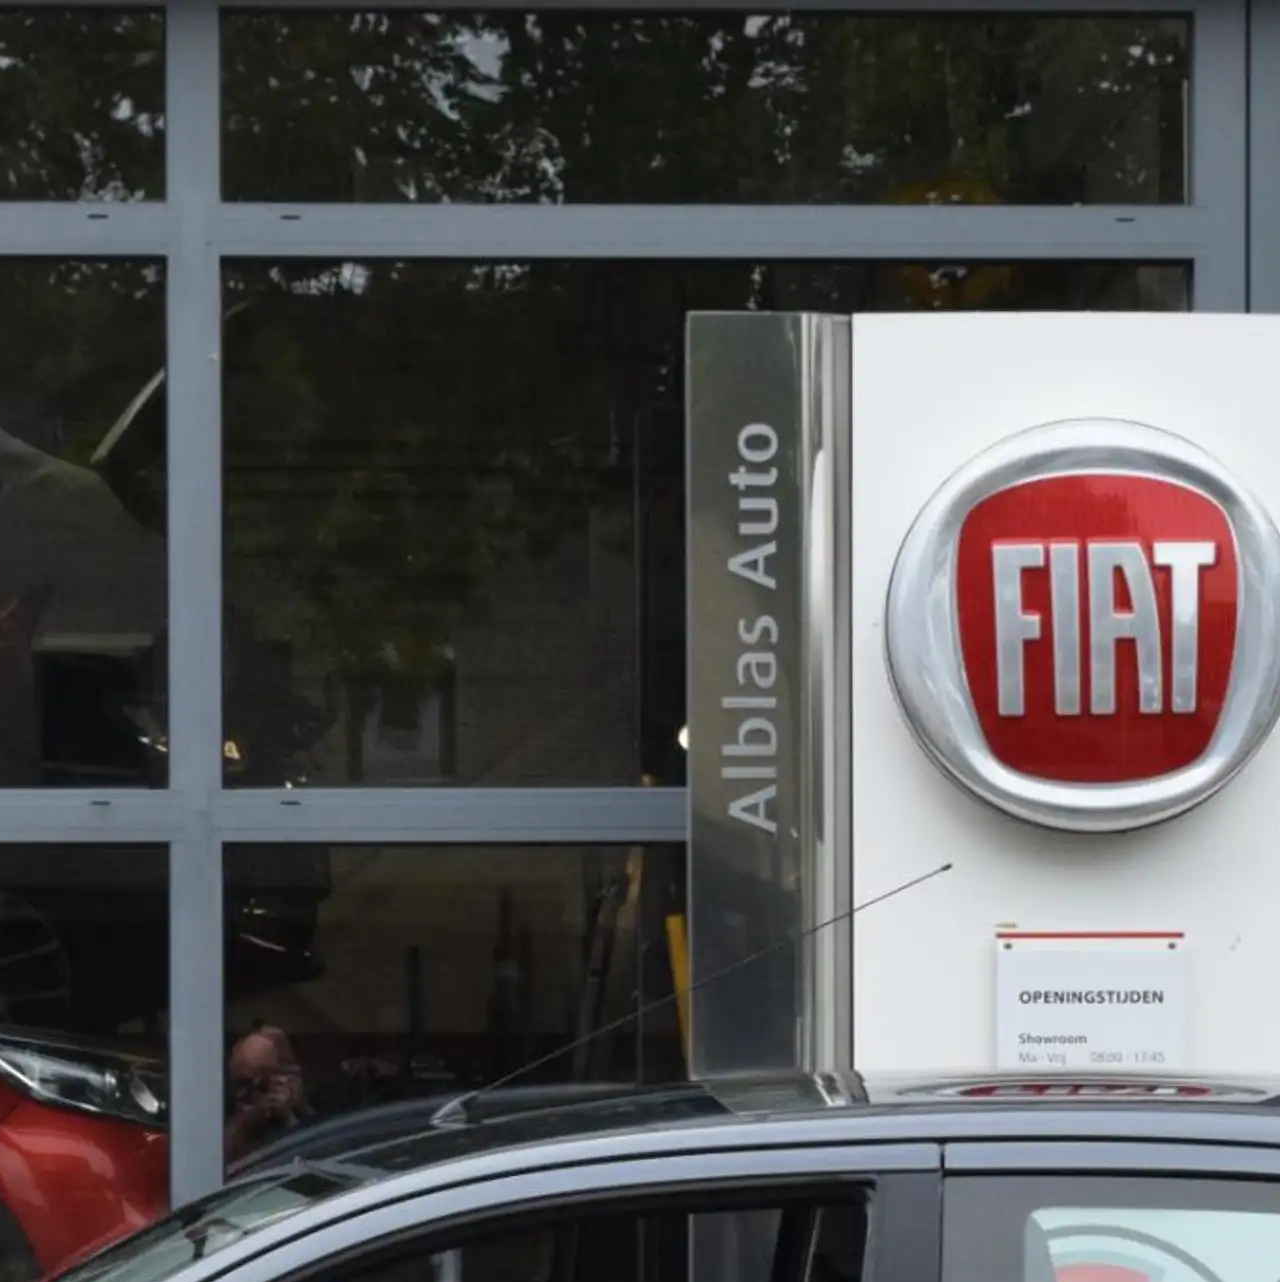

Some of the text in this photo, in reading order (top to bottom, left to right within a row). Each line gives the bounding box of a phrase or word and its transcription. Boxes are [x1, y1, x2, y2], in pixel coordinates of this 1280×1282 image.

[721, 422, 779, 833] Alblas Auto
[991, 539, 1217, 717] FIAT
[1018, 990, 1165, 1005] OPENINGSTIJDEN
[1018, 1032, 1088, 1045] Showroom
